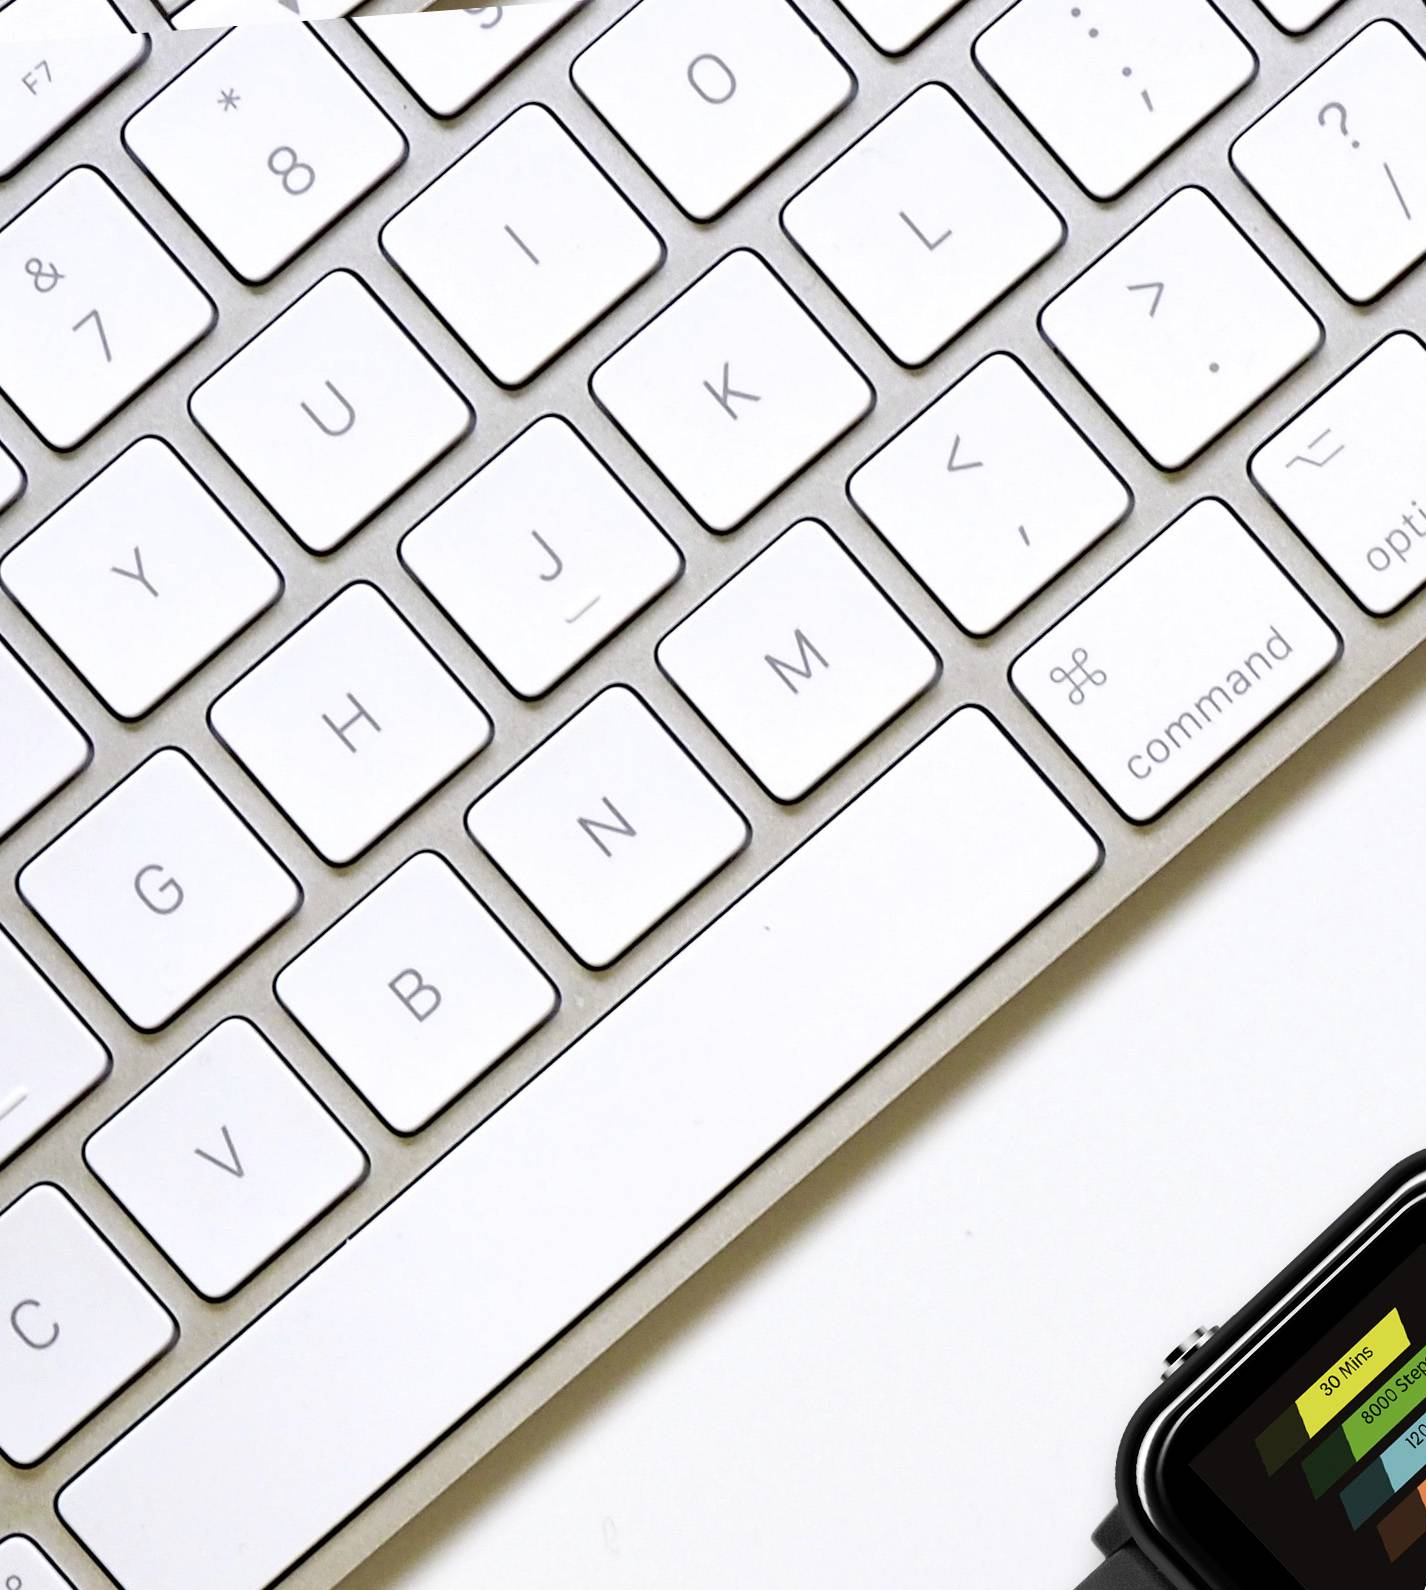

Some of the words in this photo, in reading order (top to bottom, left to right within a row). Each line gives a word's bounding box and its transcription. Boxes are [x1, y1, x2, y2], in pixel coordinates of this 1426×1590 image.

[21, 59, 52, 96] F7
[686, 53, 737, 105] O
[1317, 101, 1361, 150] ?
[267, 145, 316, 196] 8
[1383, 162, 1412, 221] /
[898, 211, 953, 252] L
[24, 257, 66, 294] &
[1126, 281, 1165, 319] >
[71, 308, 113, 363] 7
[300, 379, 356, 437] U
[702, 361, 762, 421] K
[946, 434, 984, 473] <
[110, 545, 160, 598] Y
[531, 529, 564, 582] J
[763, 628, 830, 695] M
[321, 692, 382, 754] H
[1127, 625, 1294, 780] command
[576, 795, 638, 859] N
[133, 863, 185, 916] G
[387, 967, 442, 1023] B
[193, 1124, 245, 1179] V
[9, 1298, 61, 1351] C
[1319, 1375, 1341, 1397] 30
[1338, 1346, 1374, 1380] Mins
[1361, 1388, 1398, 1425] 8000
